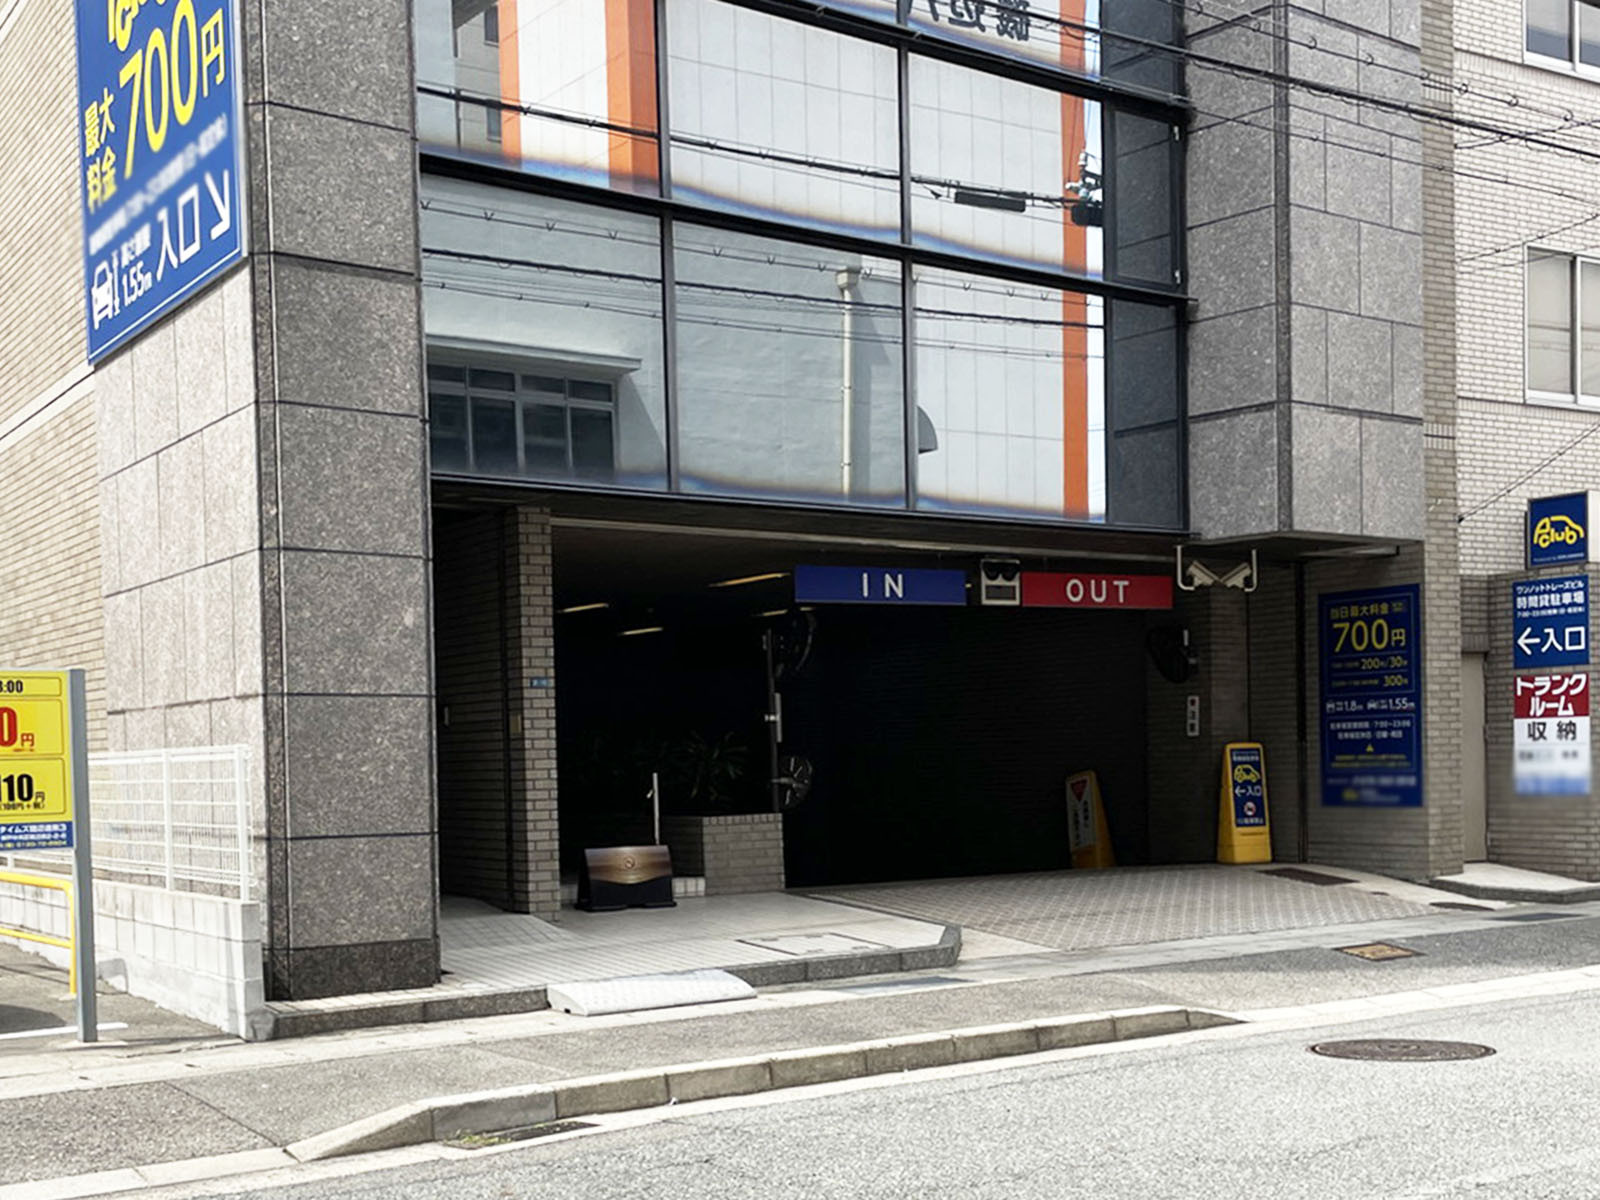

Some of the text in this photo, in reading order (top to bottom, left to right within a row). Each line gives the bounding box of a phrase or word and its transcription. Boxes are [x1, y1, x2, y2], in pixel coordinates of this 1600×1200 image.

[119, 0, 225, 180] 700円
[84, 88, 116, 158] 最大
[87, 146, 118, 214] 料金
[157, 182, 200, 283] 入口
[862, 572, 904, 598] IN
[1066, 578, 1130, 603] OUT
[1516, 590, 1585, 609] 時間貸駐車場
[1332, 618, 1406, 653] 700円
[1541, 625, 1586, 653] 入口
[1516, 673, 1587, 696] トランク
[1529, 695, 1575, 717] ルーム
[1528, 720, 1577, 742] 収納
[0, 774, 45, 802] 10円
